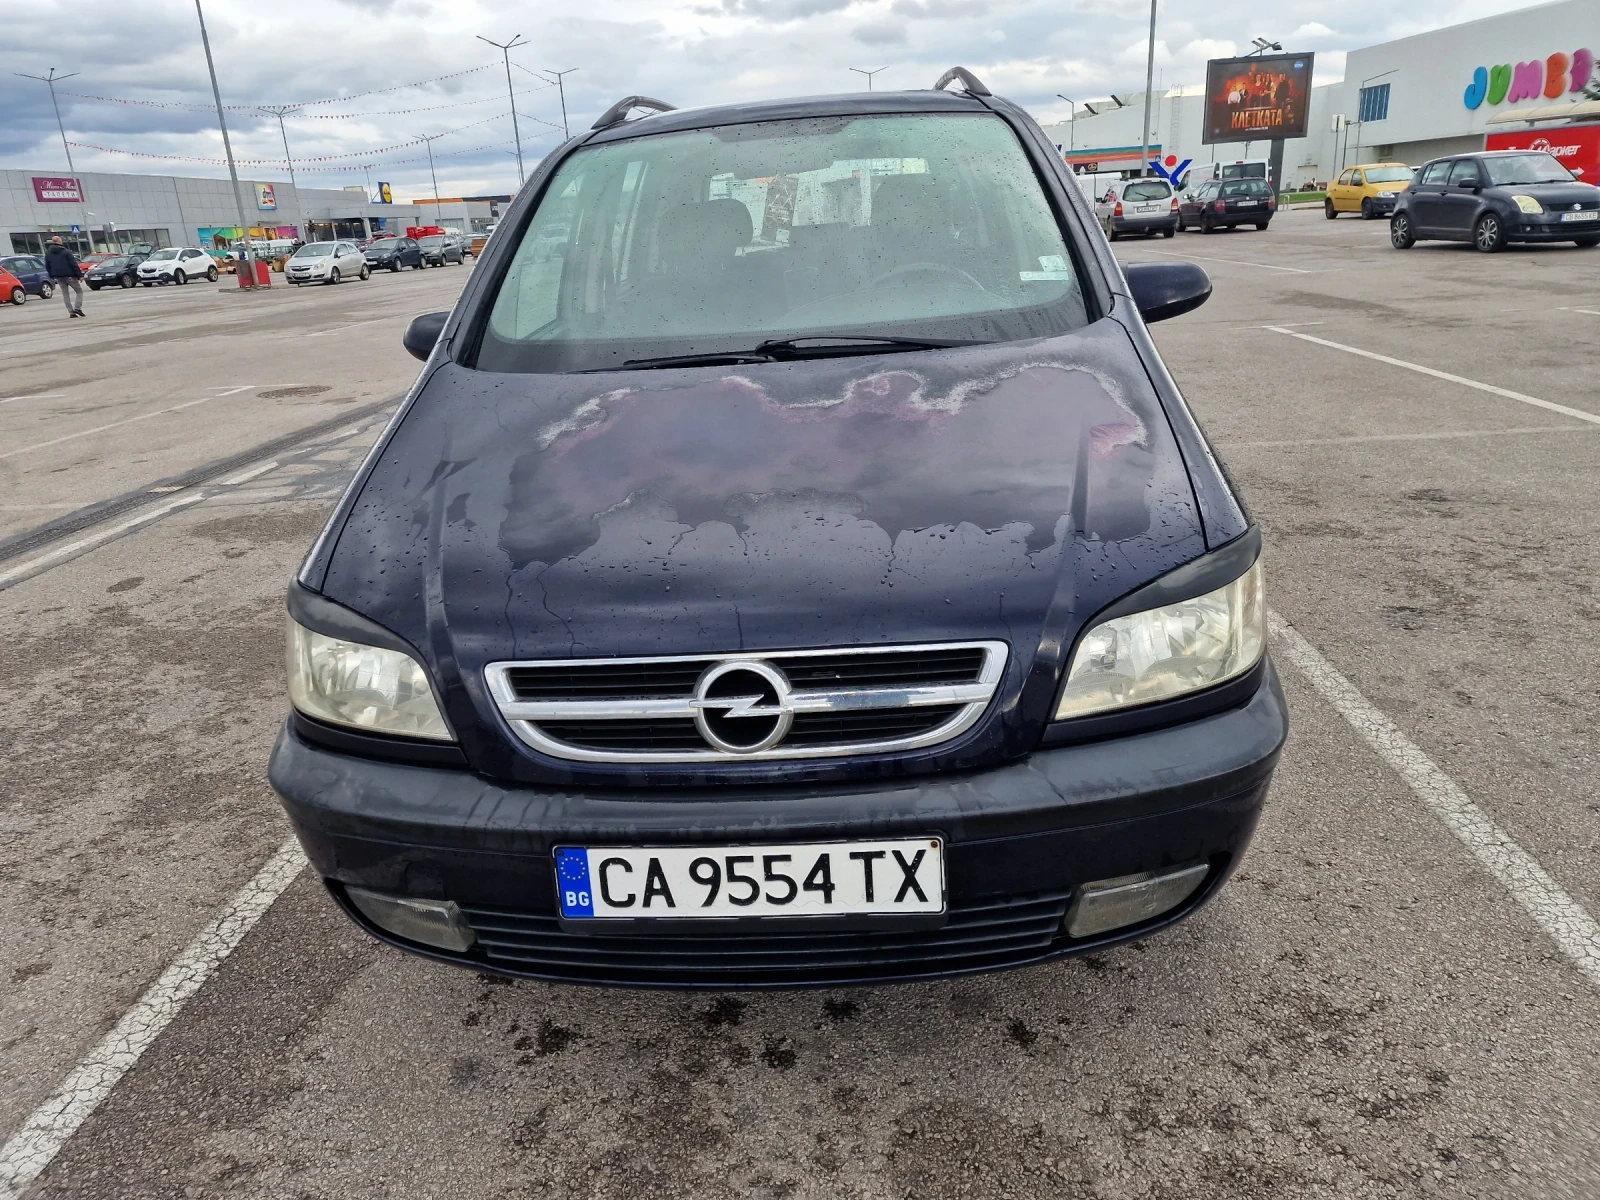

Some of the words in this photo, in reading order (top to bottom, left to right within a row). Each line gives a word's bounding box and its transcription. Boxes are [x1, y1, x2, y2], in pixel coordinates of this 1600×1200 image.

[1231, 109, 1283, 129] КЛЕТКАТА
[599, 857, 677, 909] CA
[688, 852, 837, 908] 9554
[849, 849, 930, 904] TX
[565, 891, 590, 907] BG
